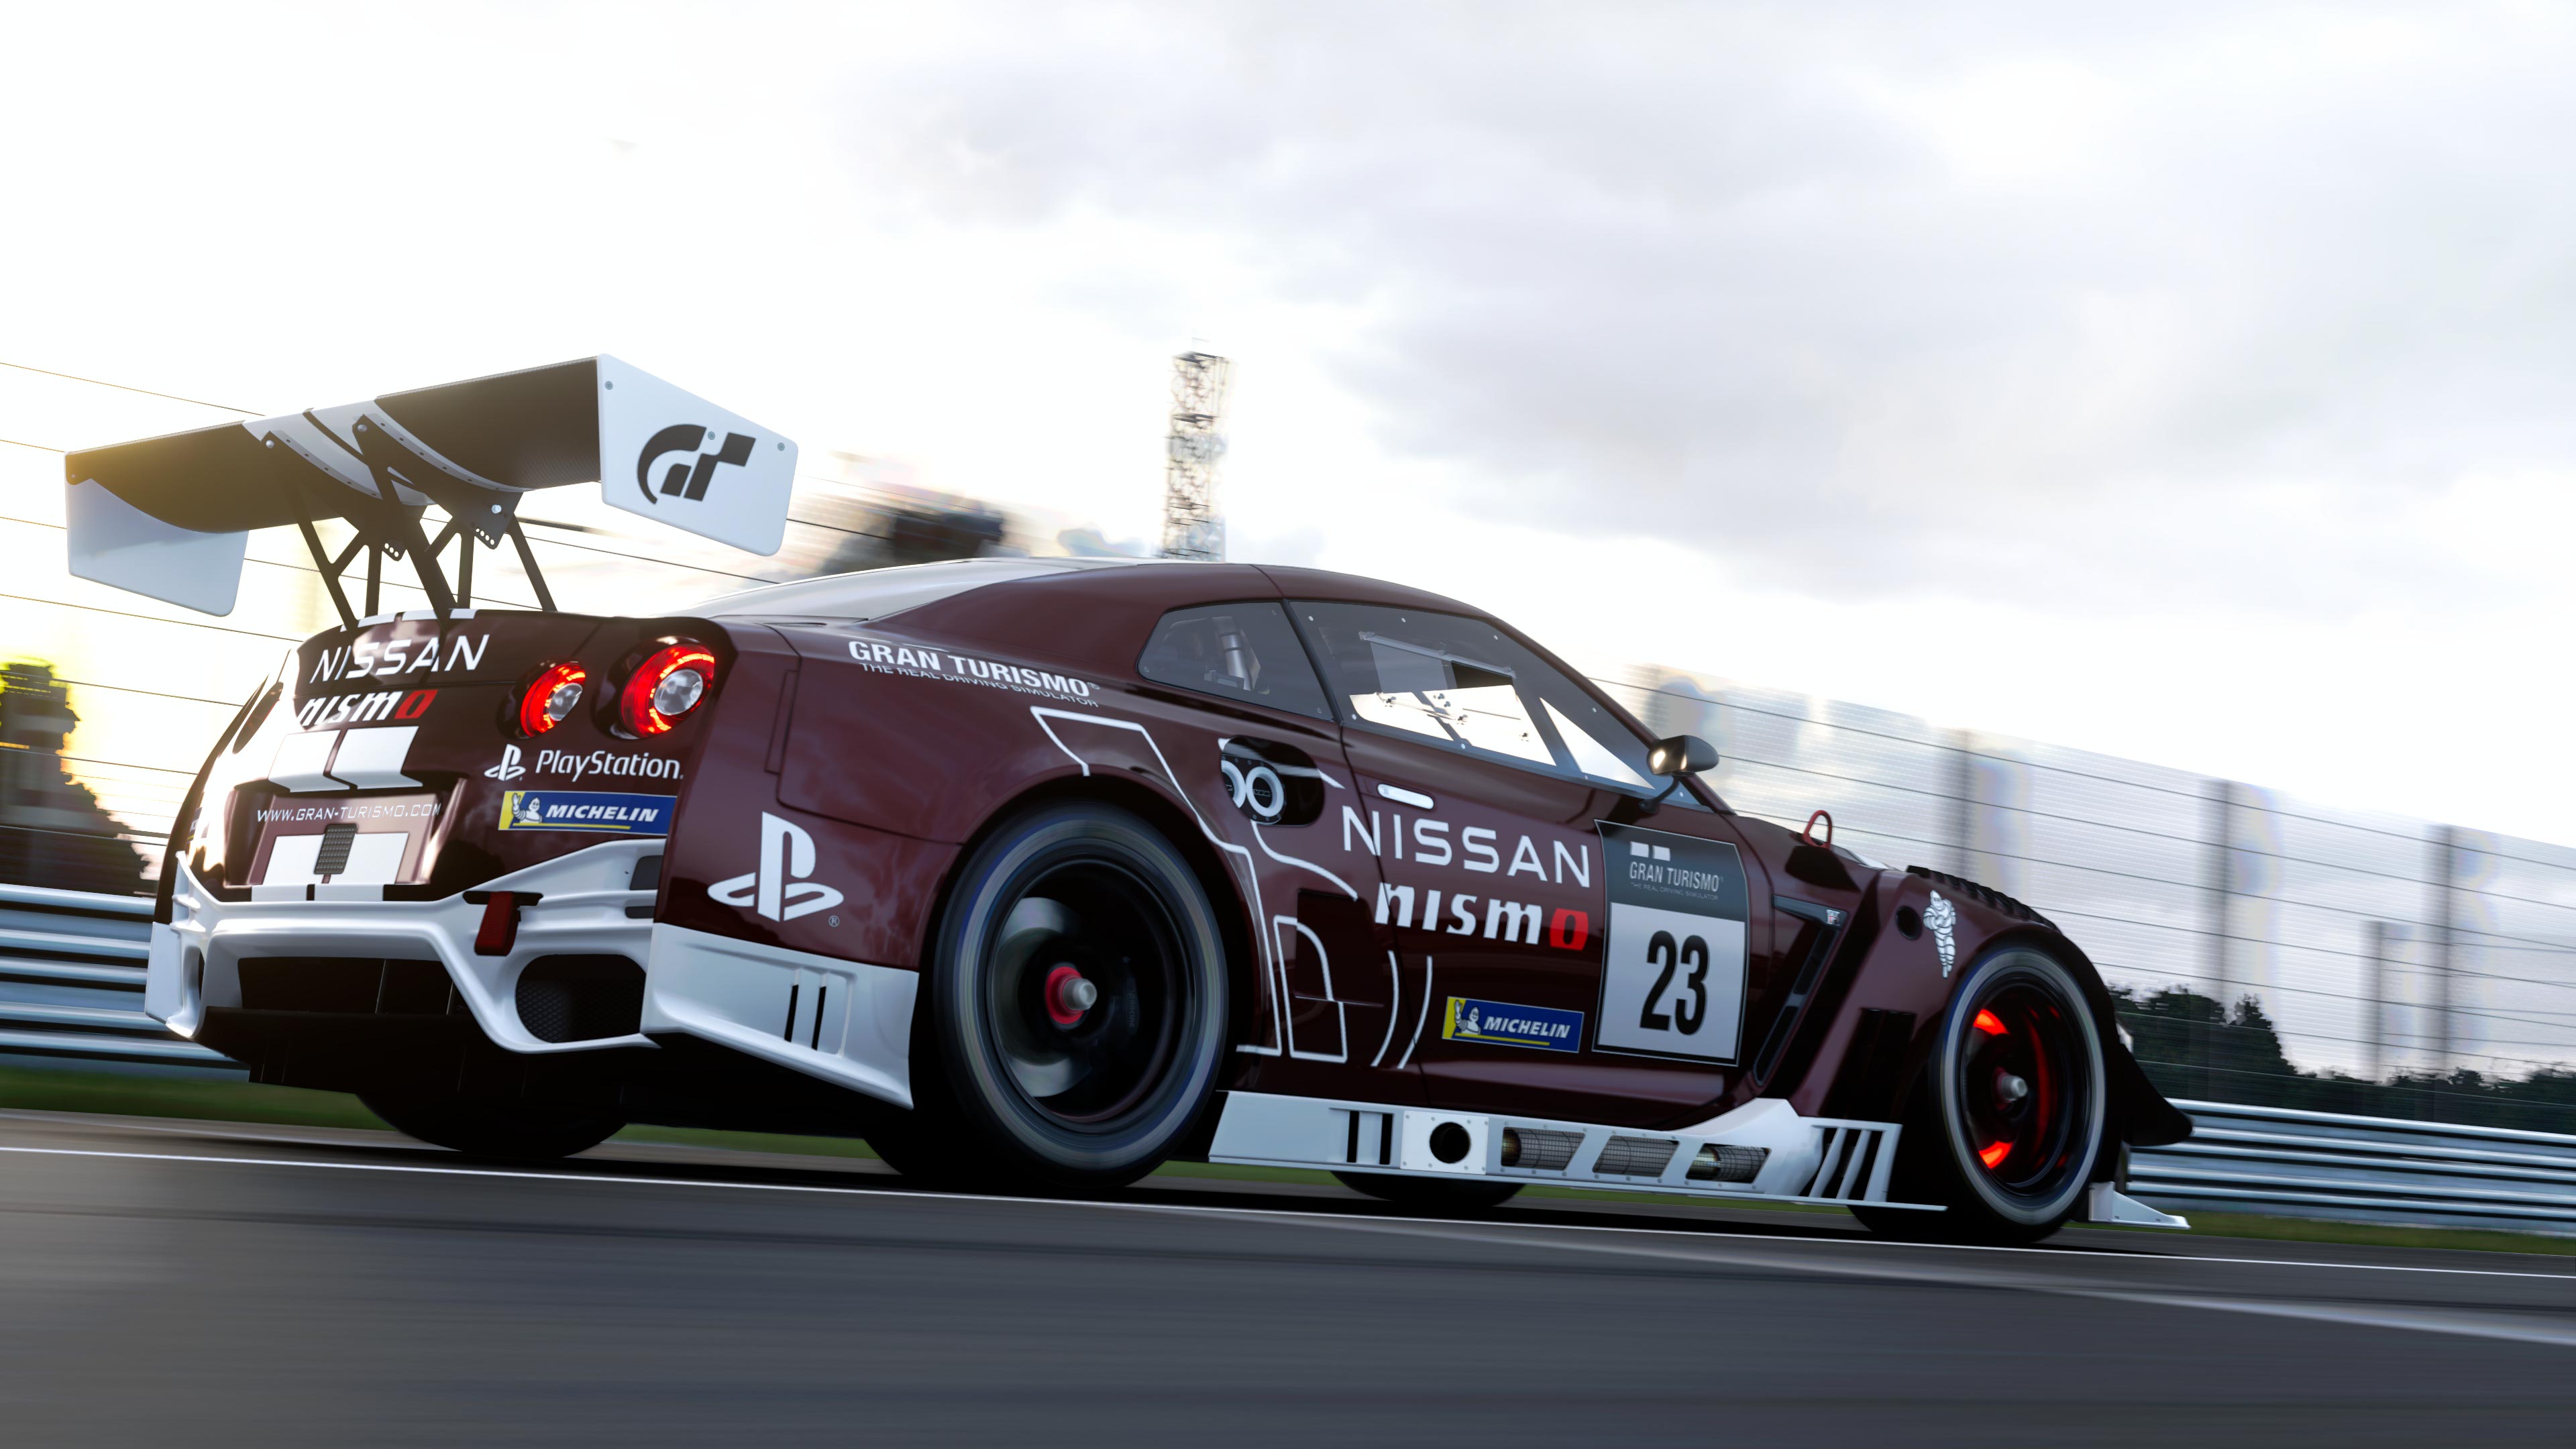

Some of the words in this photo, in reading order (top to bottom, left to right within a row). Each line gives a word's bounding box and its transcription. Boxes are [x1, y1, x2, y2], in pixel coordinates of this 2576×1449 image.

[309, 634, 490, 684] NISSAN
[848, 641, 941, 671] GRAN
[859, 663, 894, 674] THE
[898, 667, 941, 680] REAL
[942, 674, 1008, 690] DRIVING
[1010, 684, 1099, 708] SIMULATOR
[535, 749, 680, 782] PlayStation
[257, 803, 441, 822] WWW.GRAN-TURISMO.COM
[545, 805, 659, 822] MICHELIN
[1342, 805, 1591, 888] NISSAN
[1629, 861, 1663, 883] GRAN
[1644, 884, 1658, 892] REAL
[1660, 887, 1683, 896] DRIVING
[1685, 891, 1718, 900] SIMULATOR
[1640, 930, 1711, 1036] 23
[1483, 1016, 1570, 1039] MICHELIN
